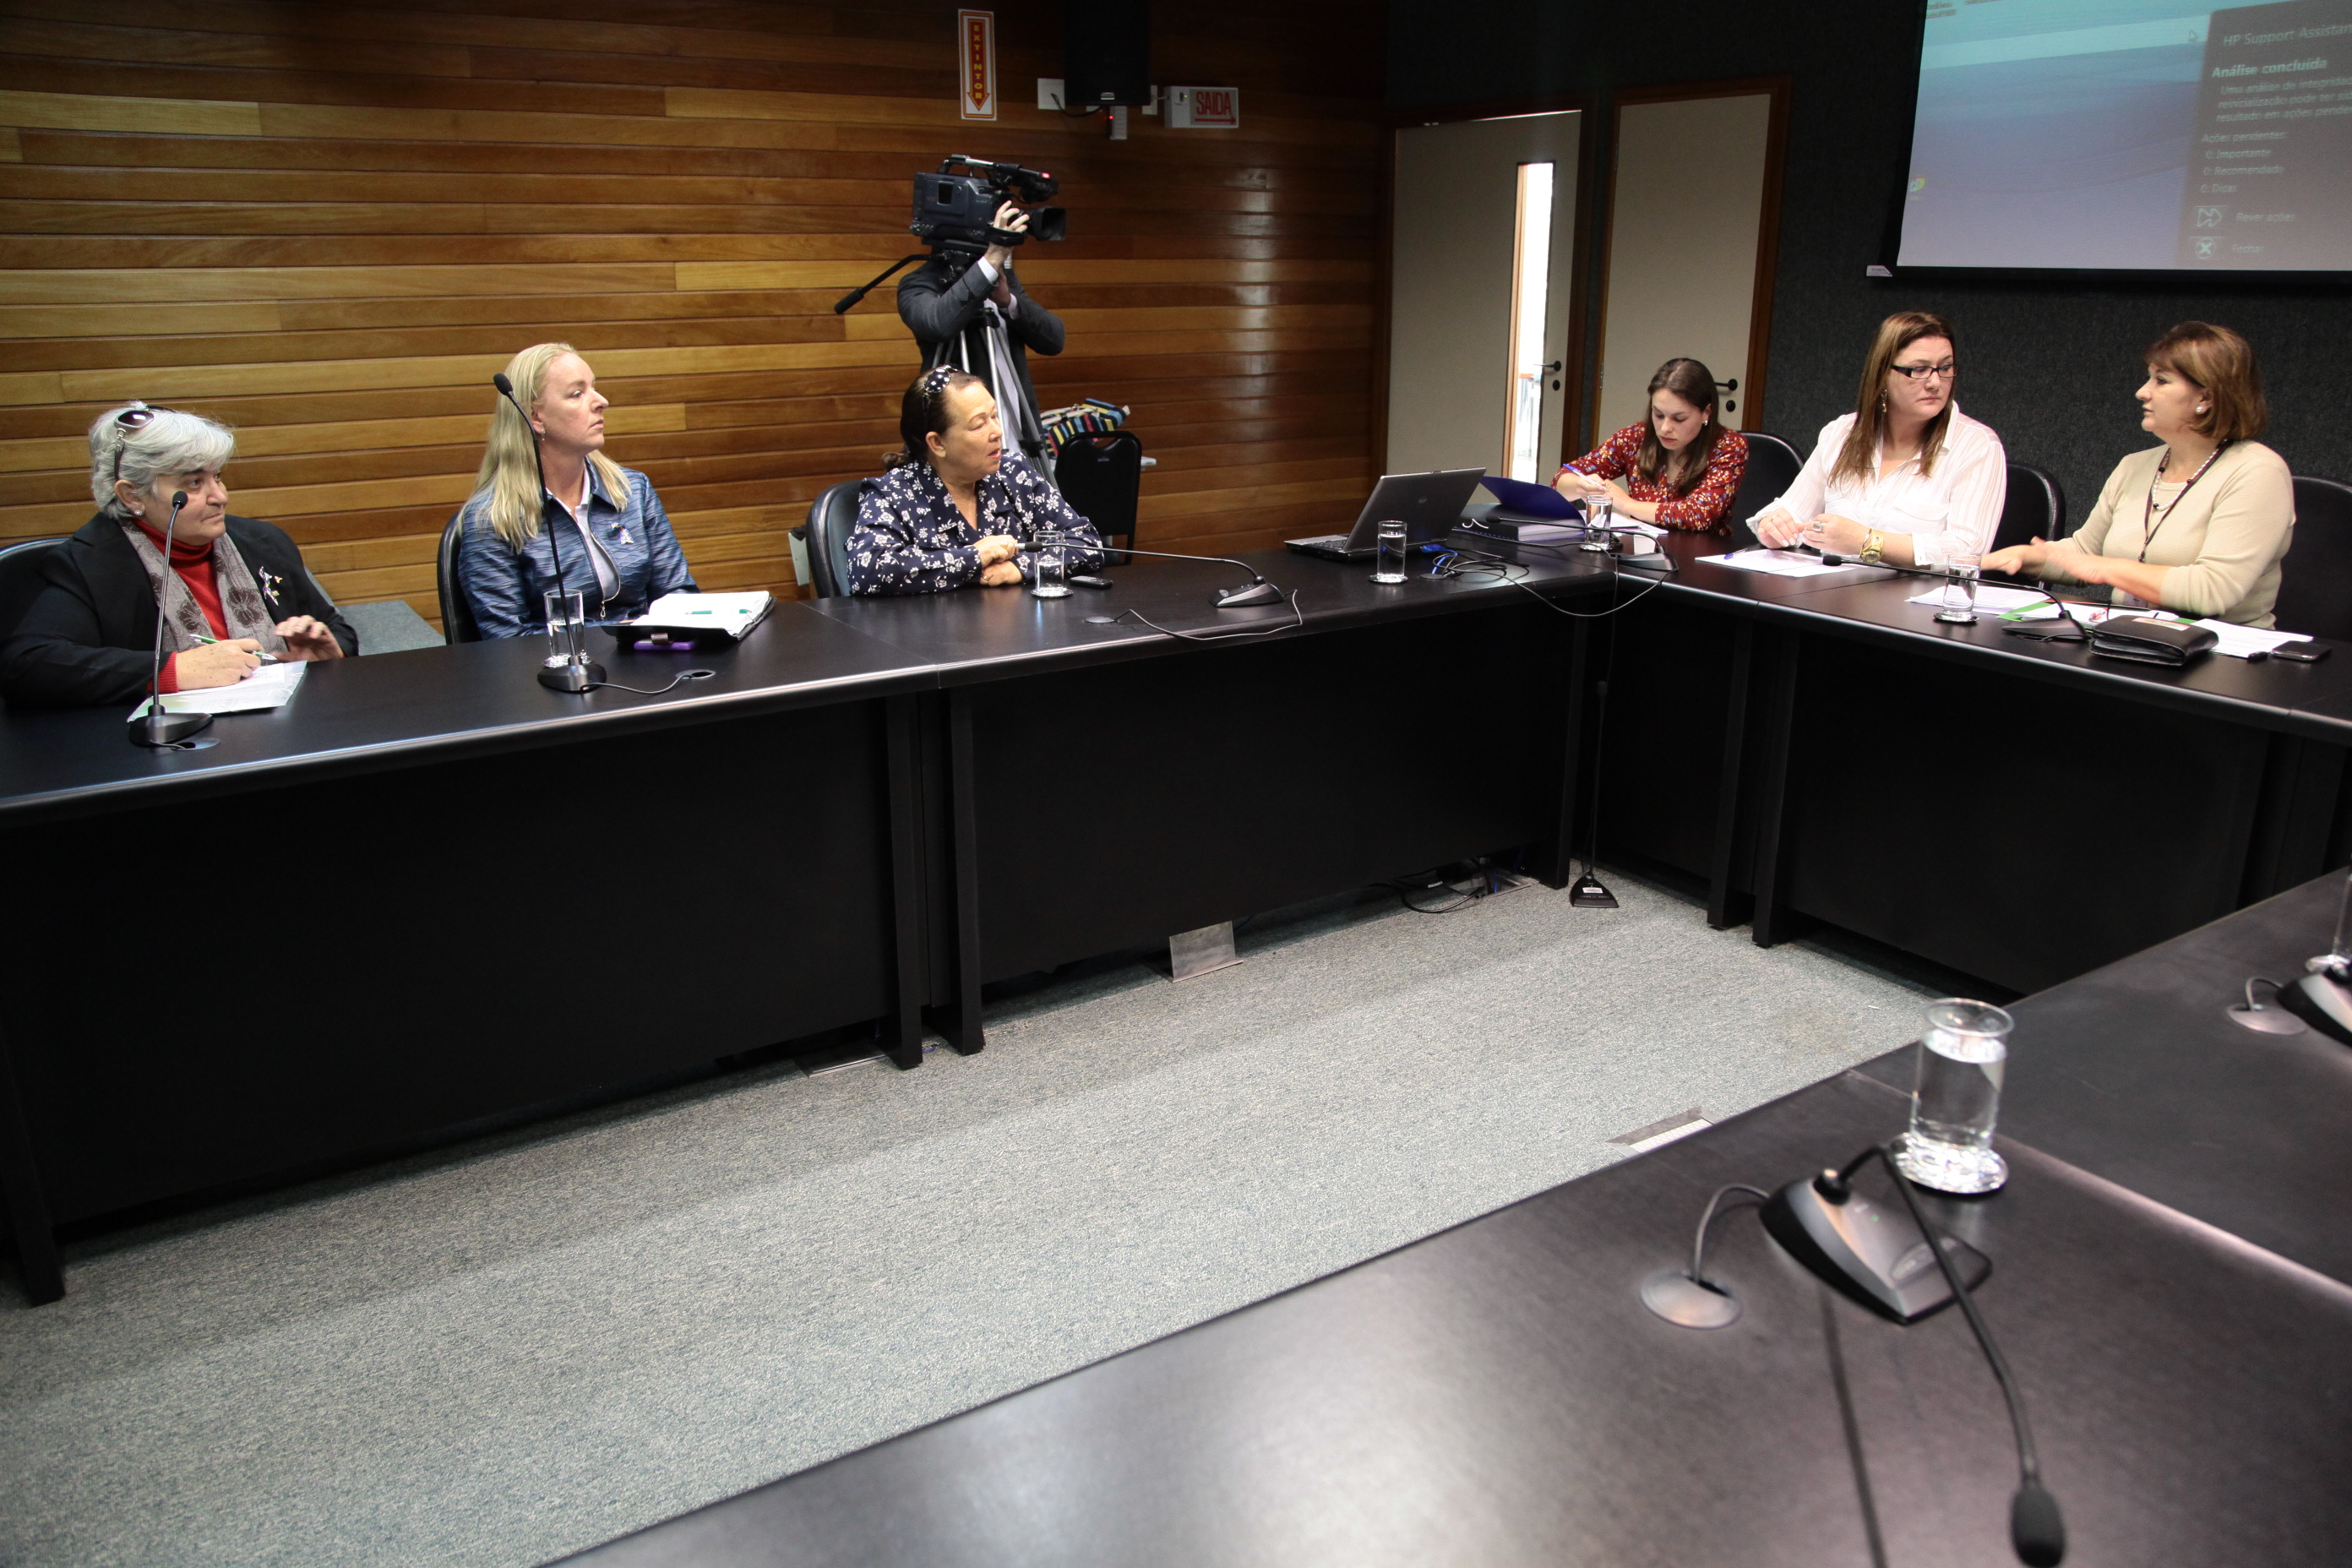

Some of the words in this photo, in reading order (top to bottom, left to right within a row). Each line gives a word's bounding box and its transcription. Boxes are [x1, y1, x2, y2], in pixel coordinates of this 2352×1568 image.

[2224, 35, 2240, 46] HP
[2243, 30, 2294, 45] Support
[2298, 24, 2352, 38] Assistan
[973, 24, 983, 99] EXTINTOR
[2212, 64, 2257, 78] Análise
